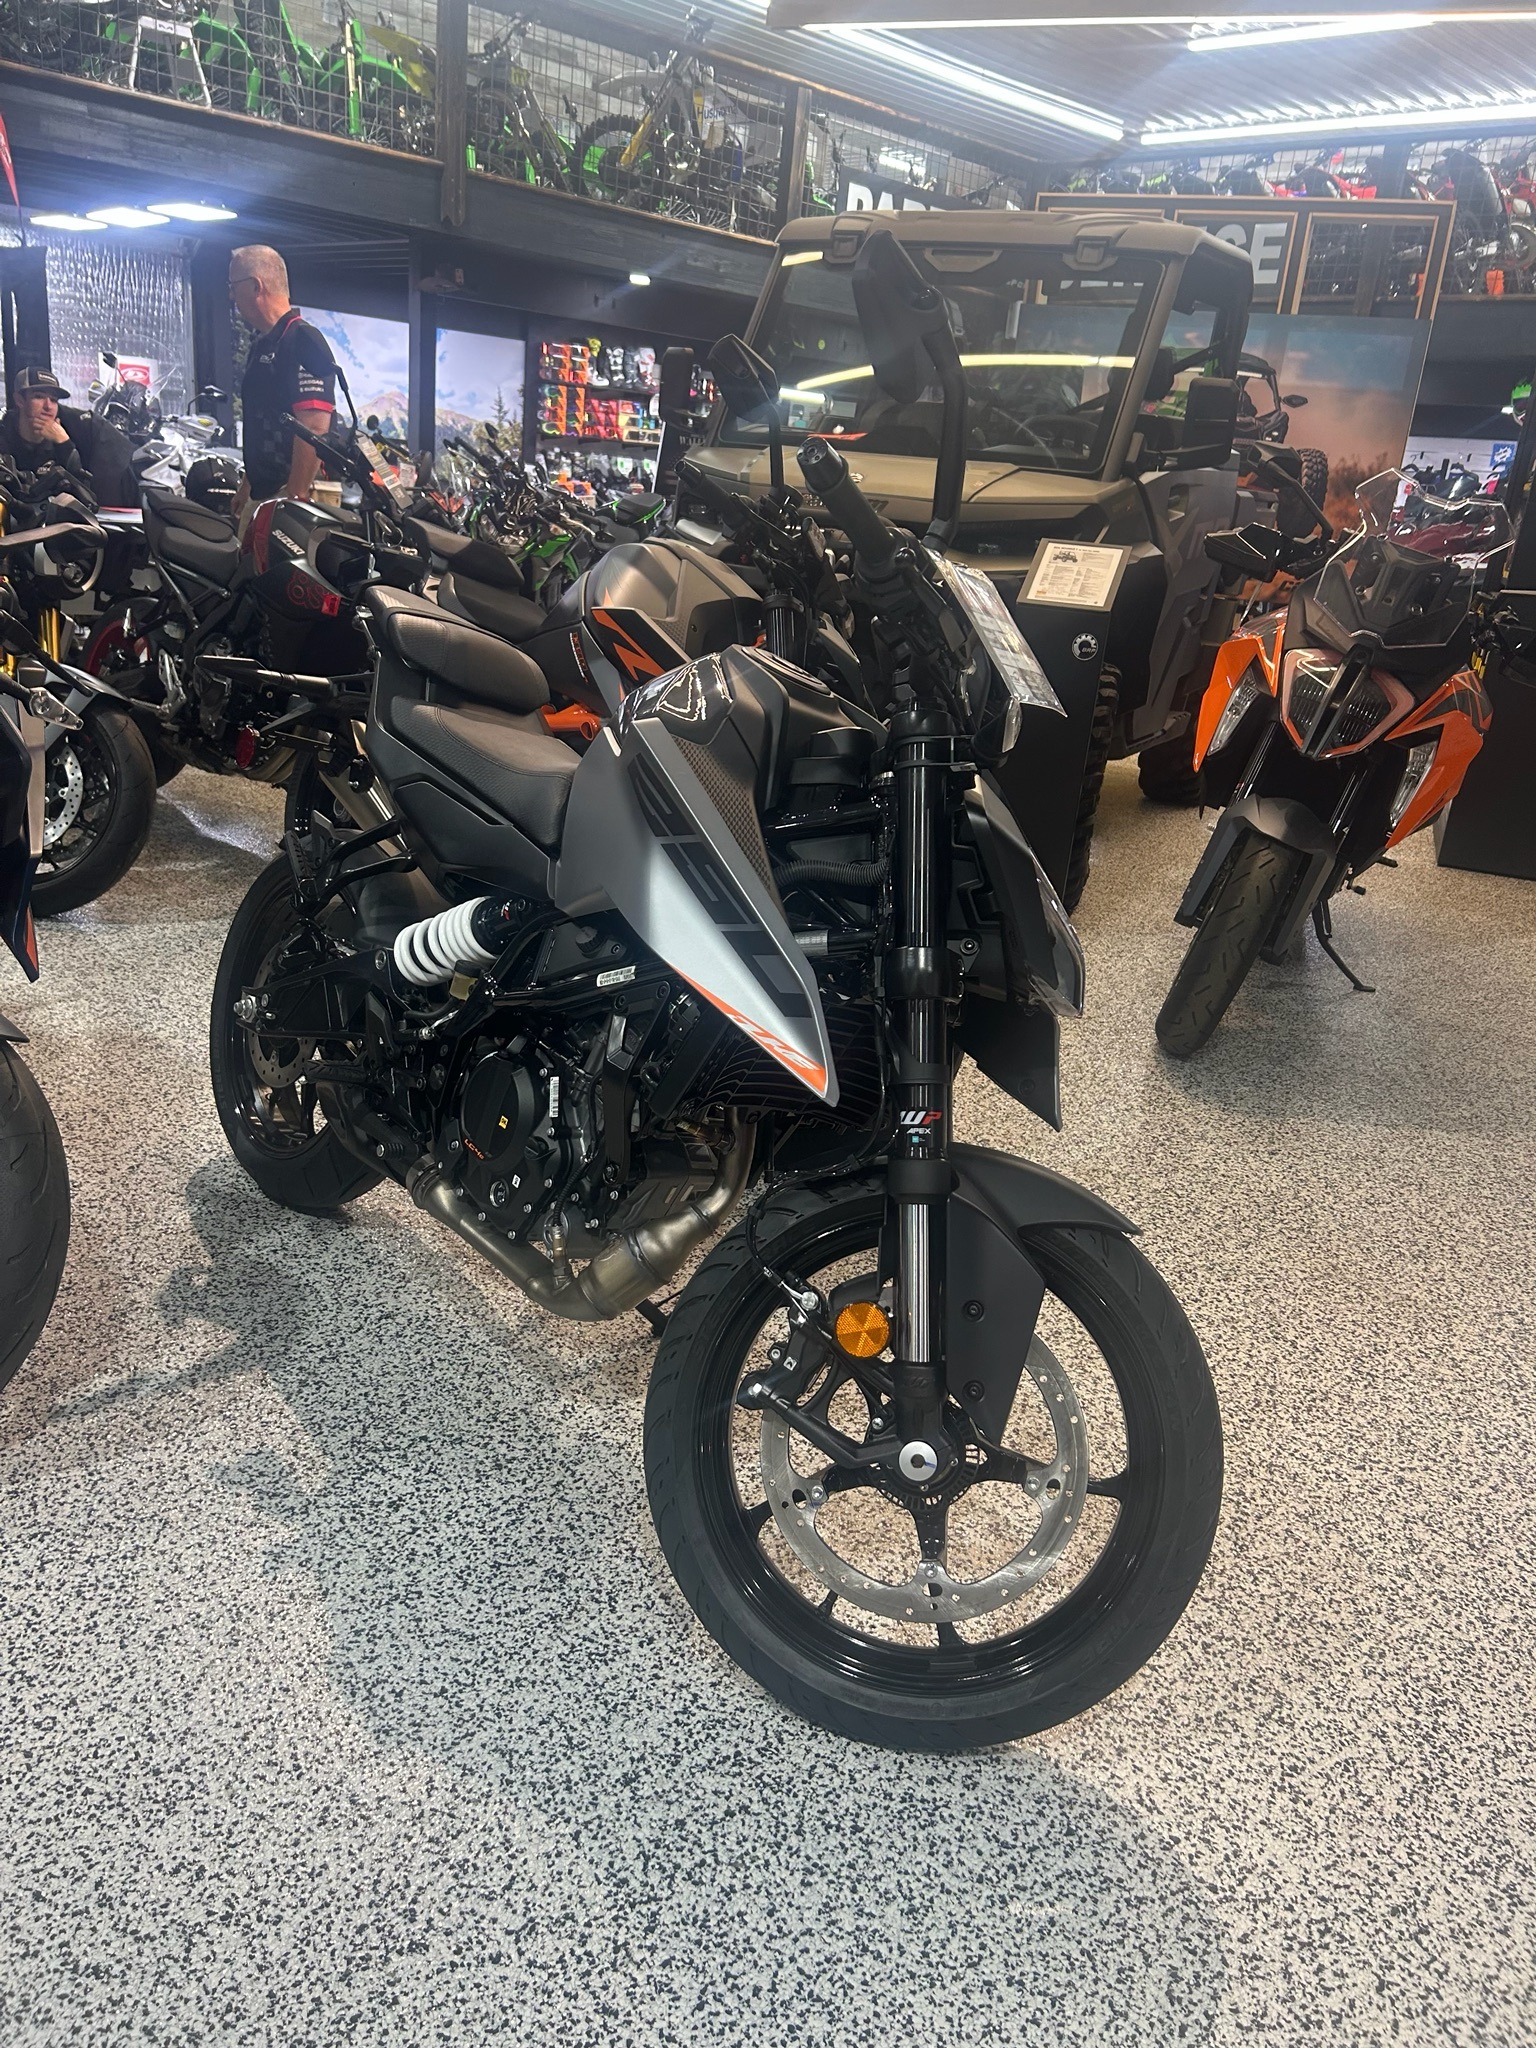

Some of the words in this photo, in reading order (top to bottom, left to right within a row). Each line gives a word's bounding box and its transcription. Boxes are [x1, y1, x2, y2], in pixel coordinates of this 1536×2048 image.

[272, 529, 306, 555] SUZUKI
[900, 1110, 942, 1125] WP
[906, 1127, 932, 1135] APEX
